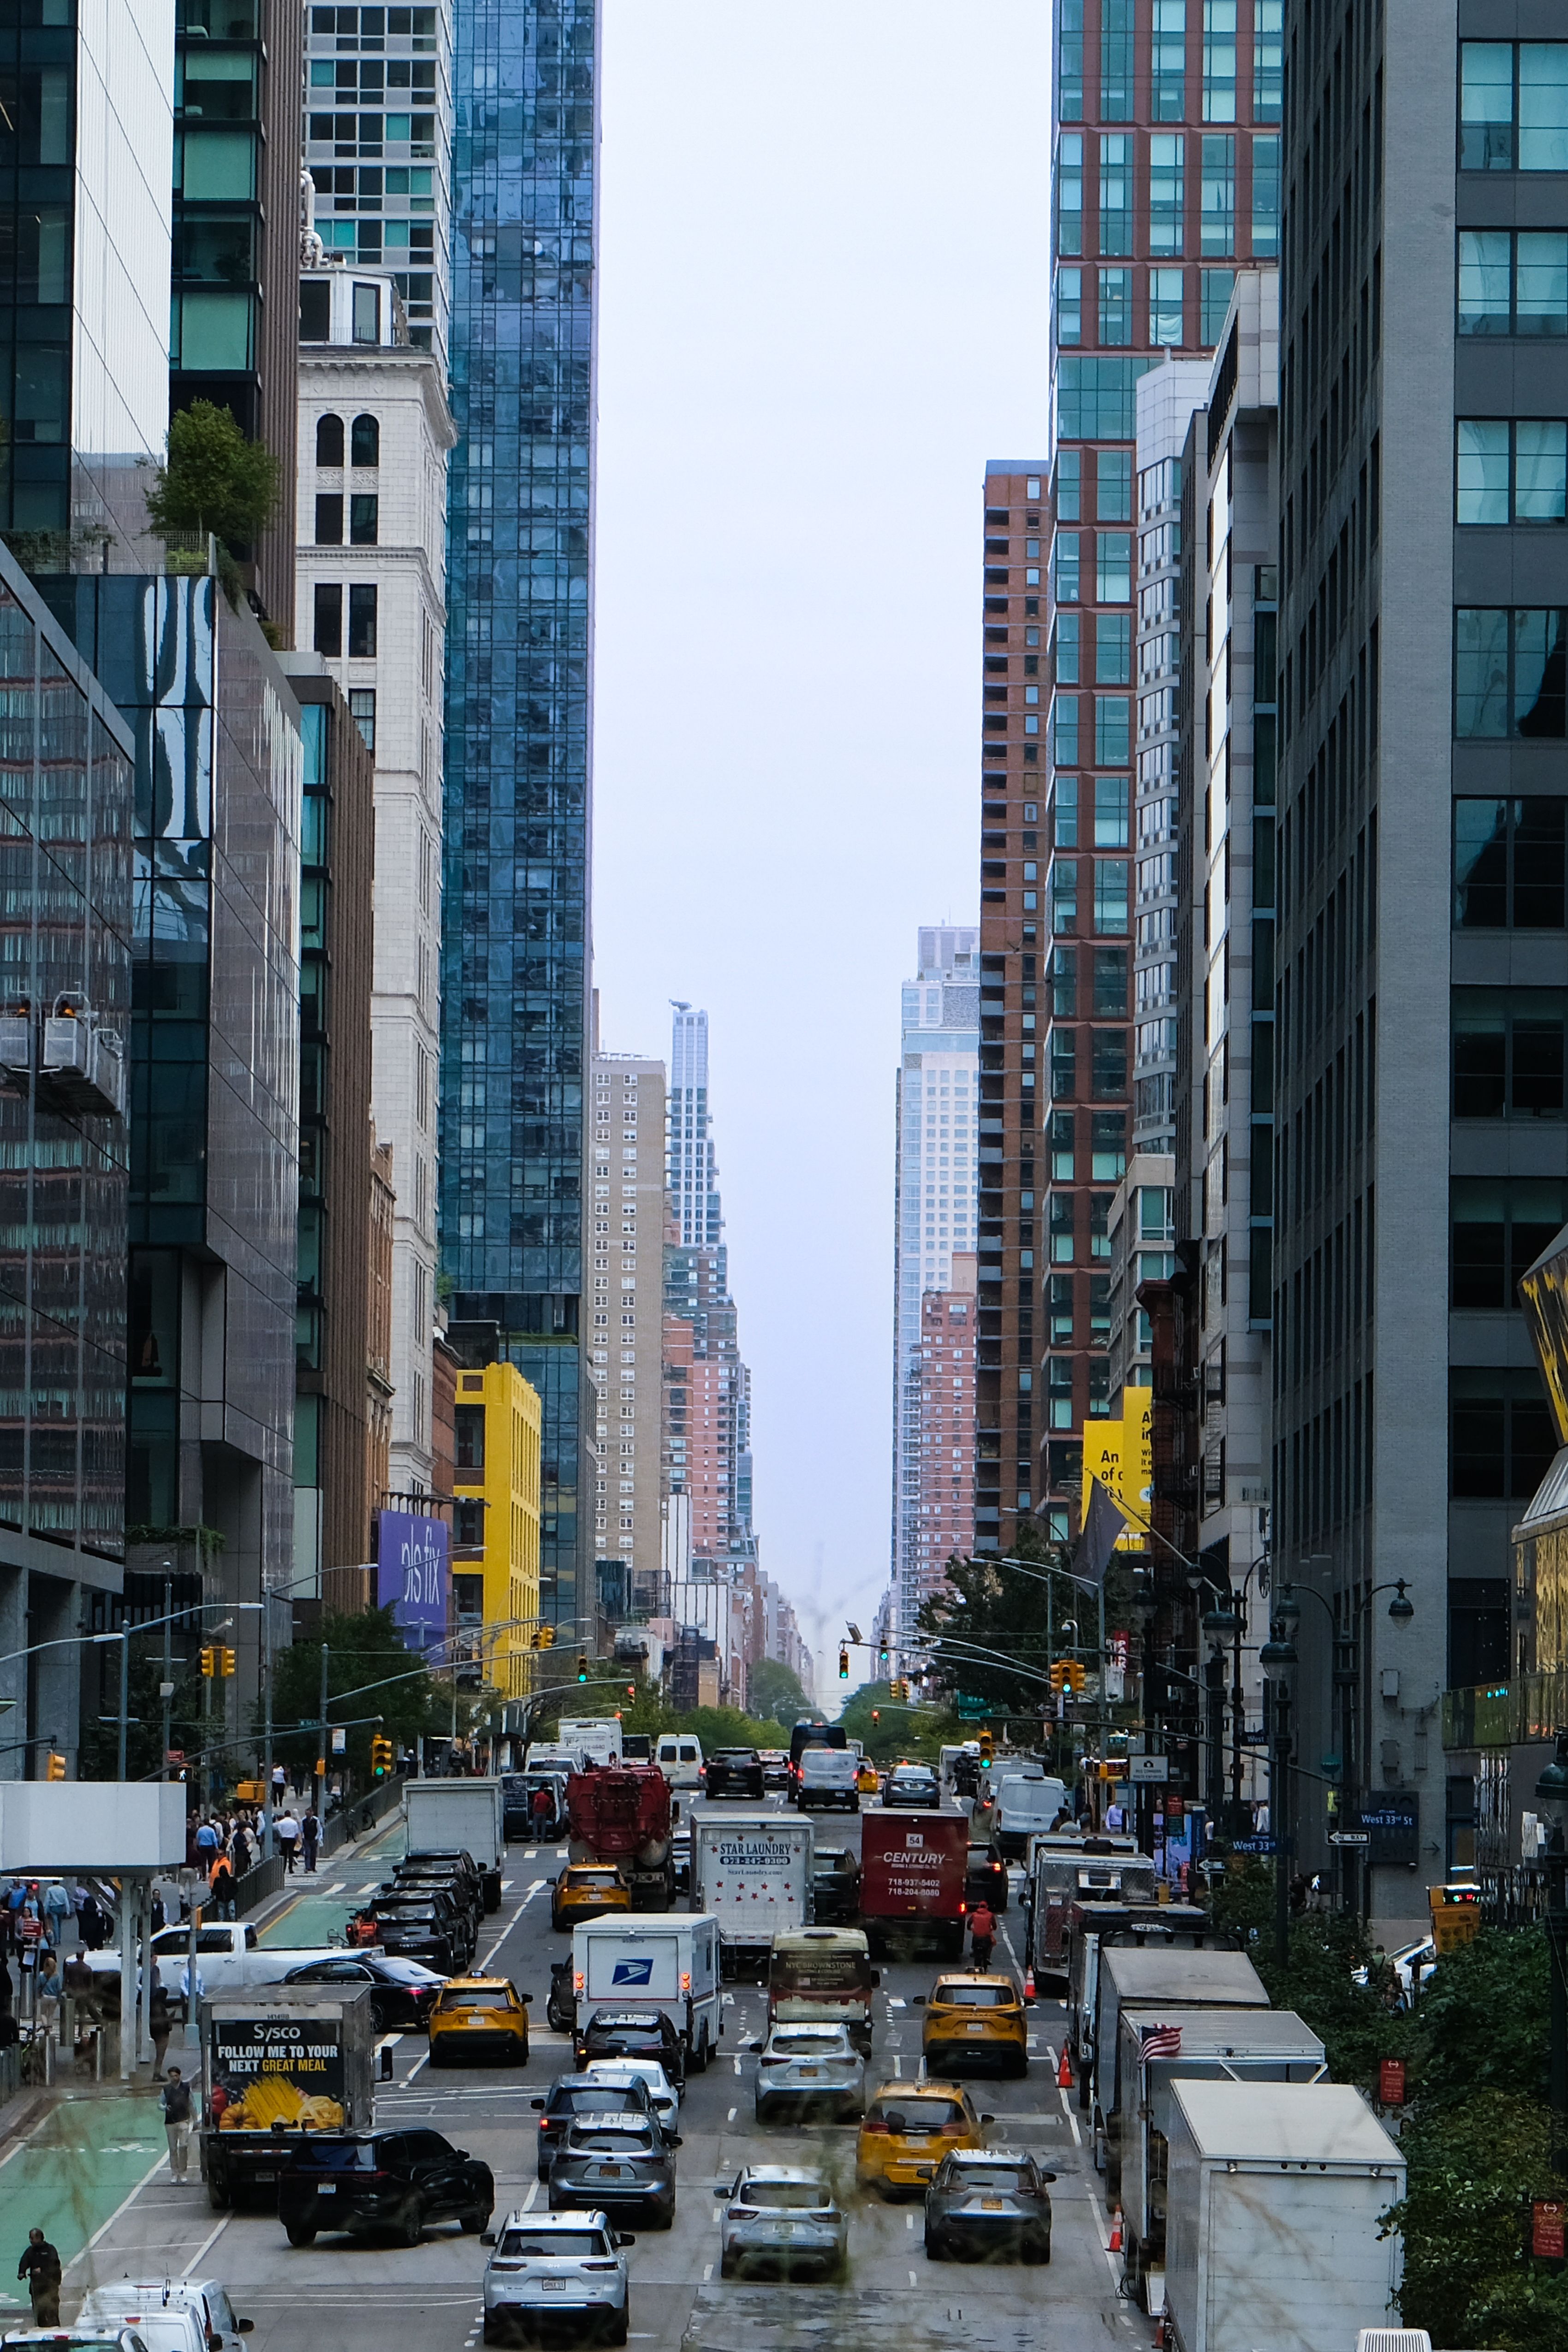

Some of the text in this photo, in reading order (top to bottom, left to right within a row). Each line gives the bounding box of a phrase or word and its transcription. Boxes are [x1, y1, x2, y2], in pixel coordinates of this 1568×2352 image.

[1101, 1449, 1119, 1463] An
[1101, 1467, 1115, 1481] of
[424, 1525, 440, 1605] fix
[1361, 1814, 1383, 1824] West
[1403, 1816, 1413, 1825] St
[720, 1843, 791, 1855] STAR LAUNDRY
[1233, 1841, 1255, 1851] West
[883, 1852, 945, 1864] CENTURY
[254, 2024, 301, 2042] Sysco
[218, 2045, 338, 2058] FOLLOW ME TO YOUR
[229, 2059, 327, 2072] NEXT GREAT MEAL
